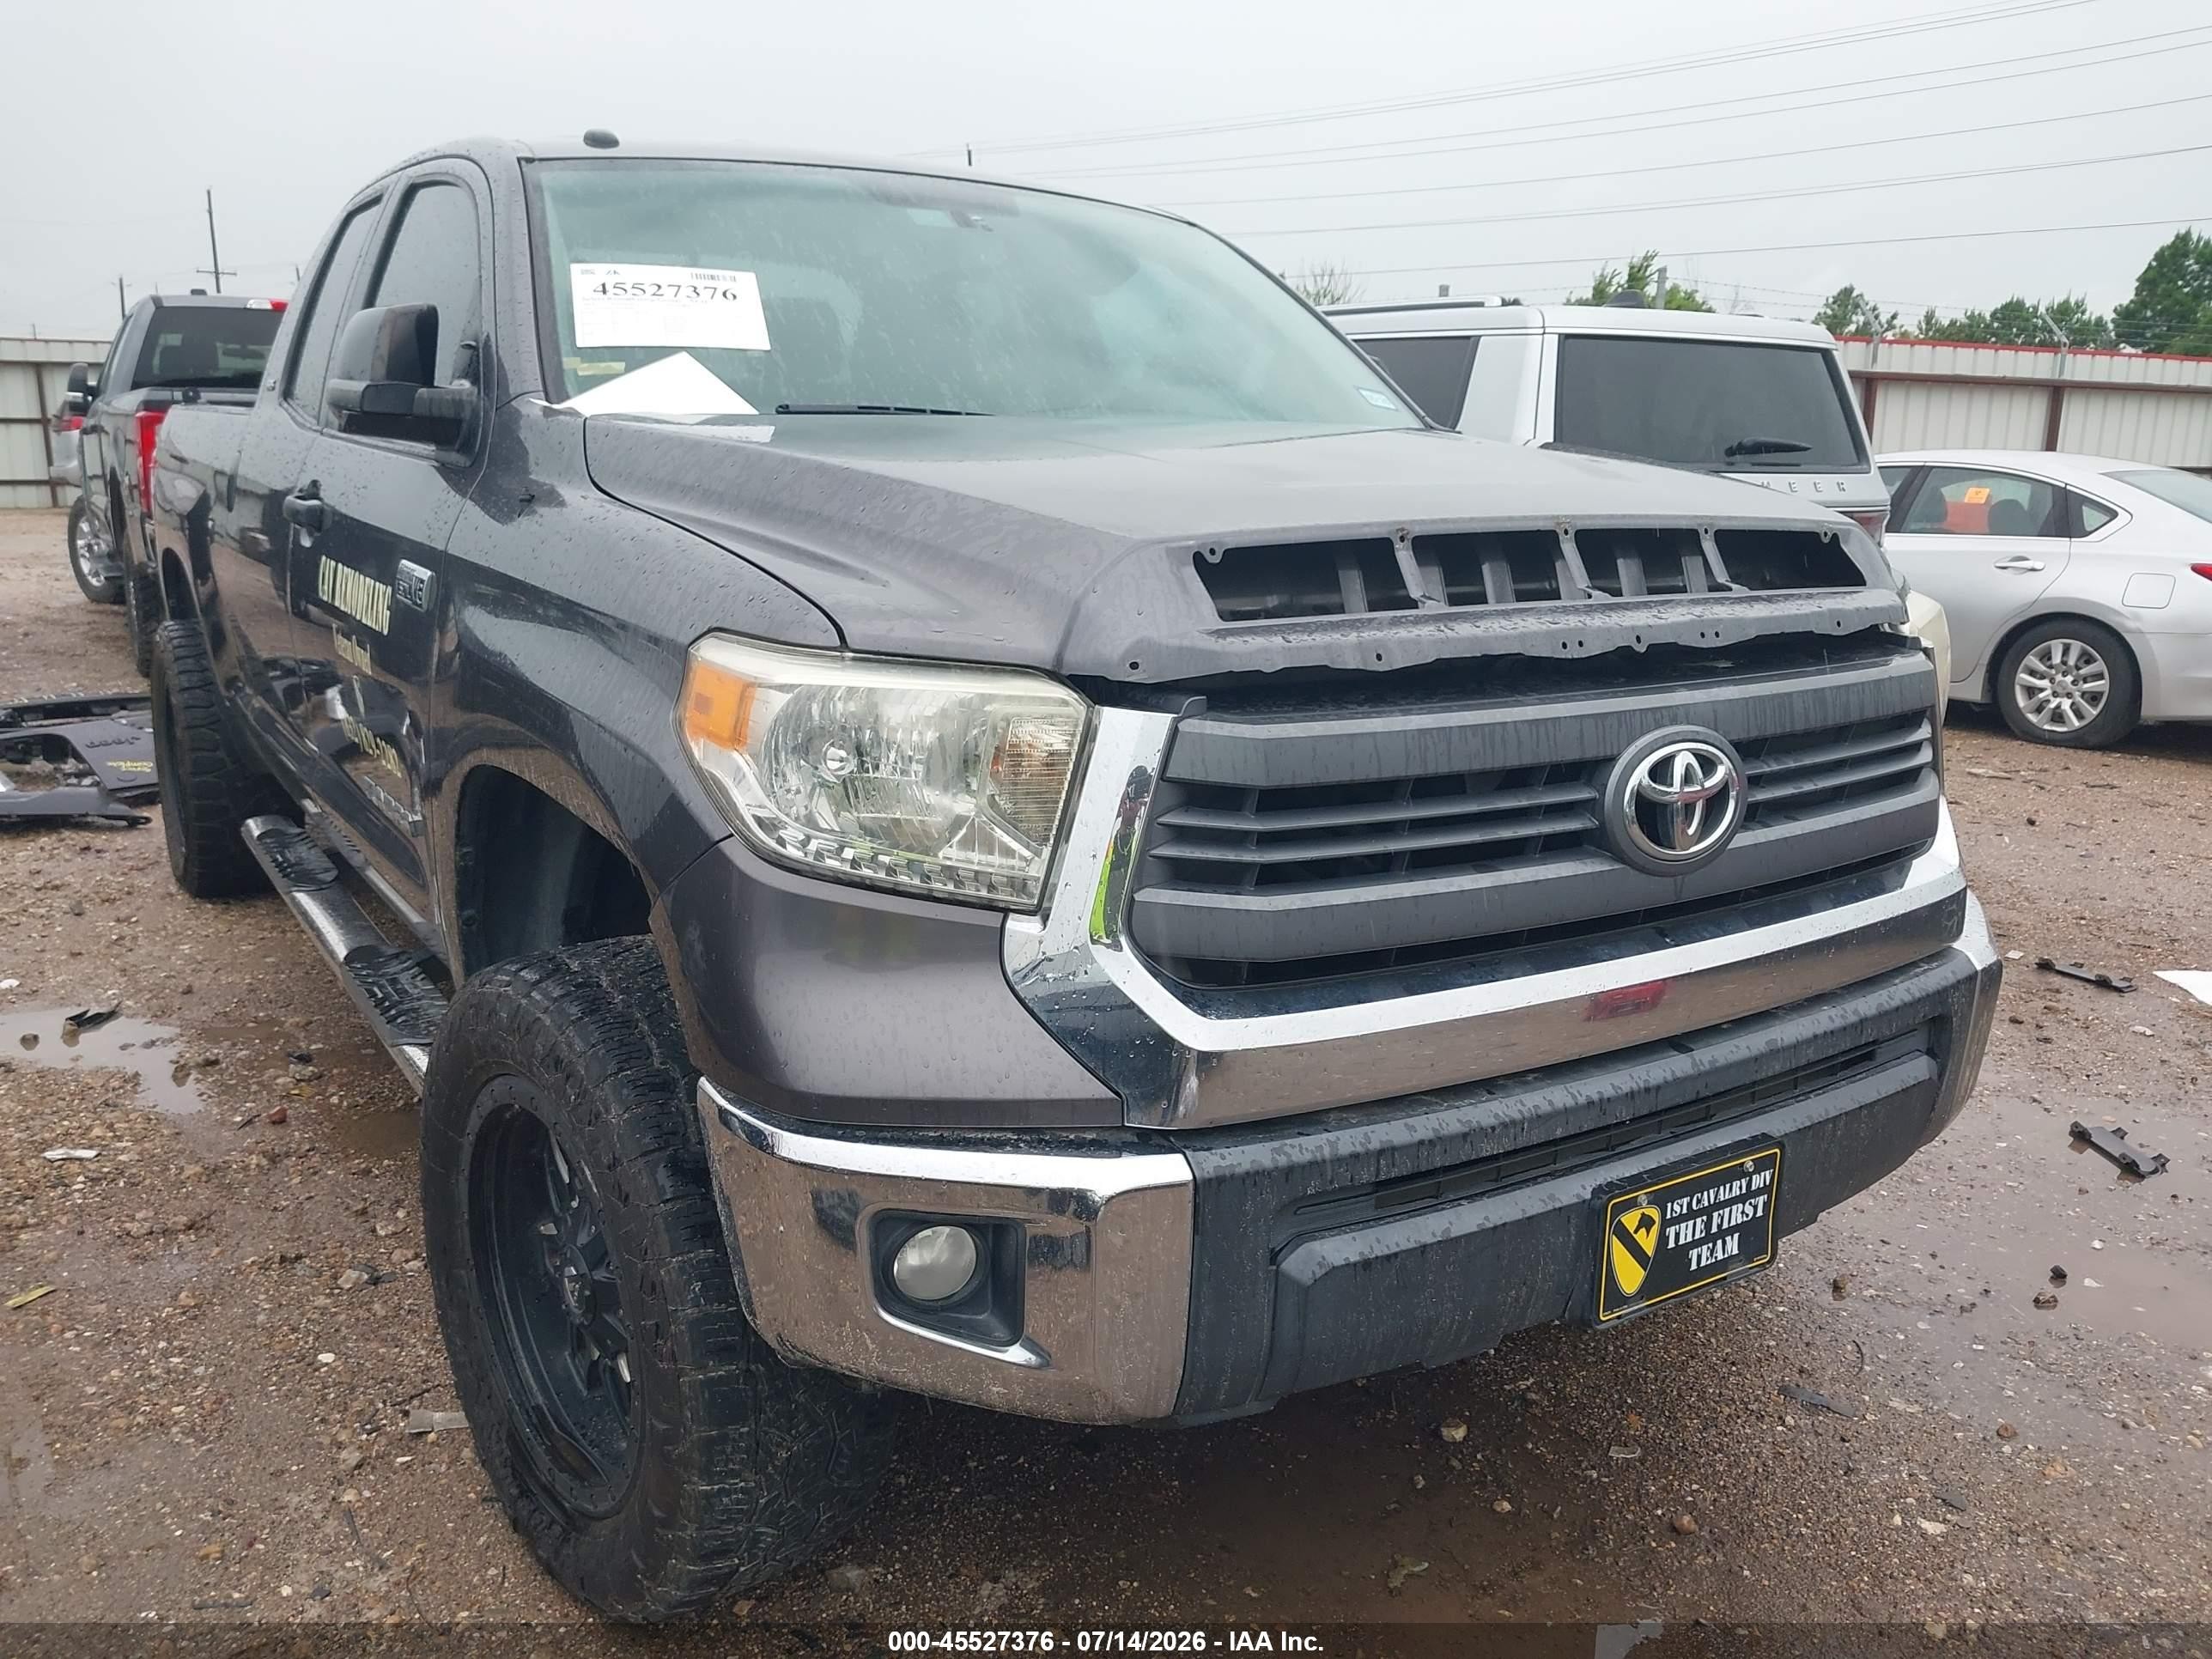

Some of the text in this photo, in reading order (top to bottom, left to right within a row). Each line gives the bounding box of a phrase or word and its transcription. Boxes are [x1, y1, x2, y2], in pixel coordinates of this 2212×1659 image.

[592, 281, 738, 301] 45527376
[335, 562, 392, 636] REMODELING
[1665, 1169, 1774, 1219] 1ST CAVALRY DIV
[1665, 1194, 1768, 1249] THE FIRST
[1688, 1232, 1741, 1272] TEAM
